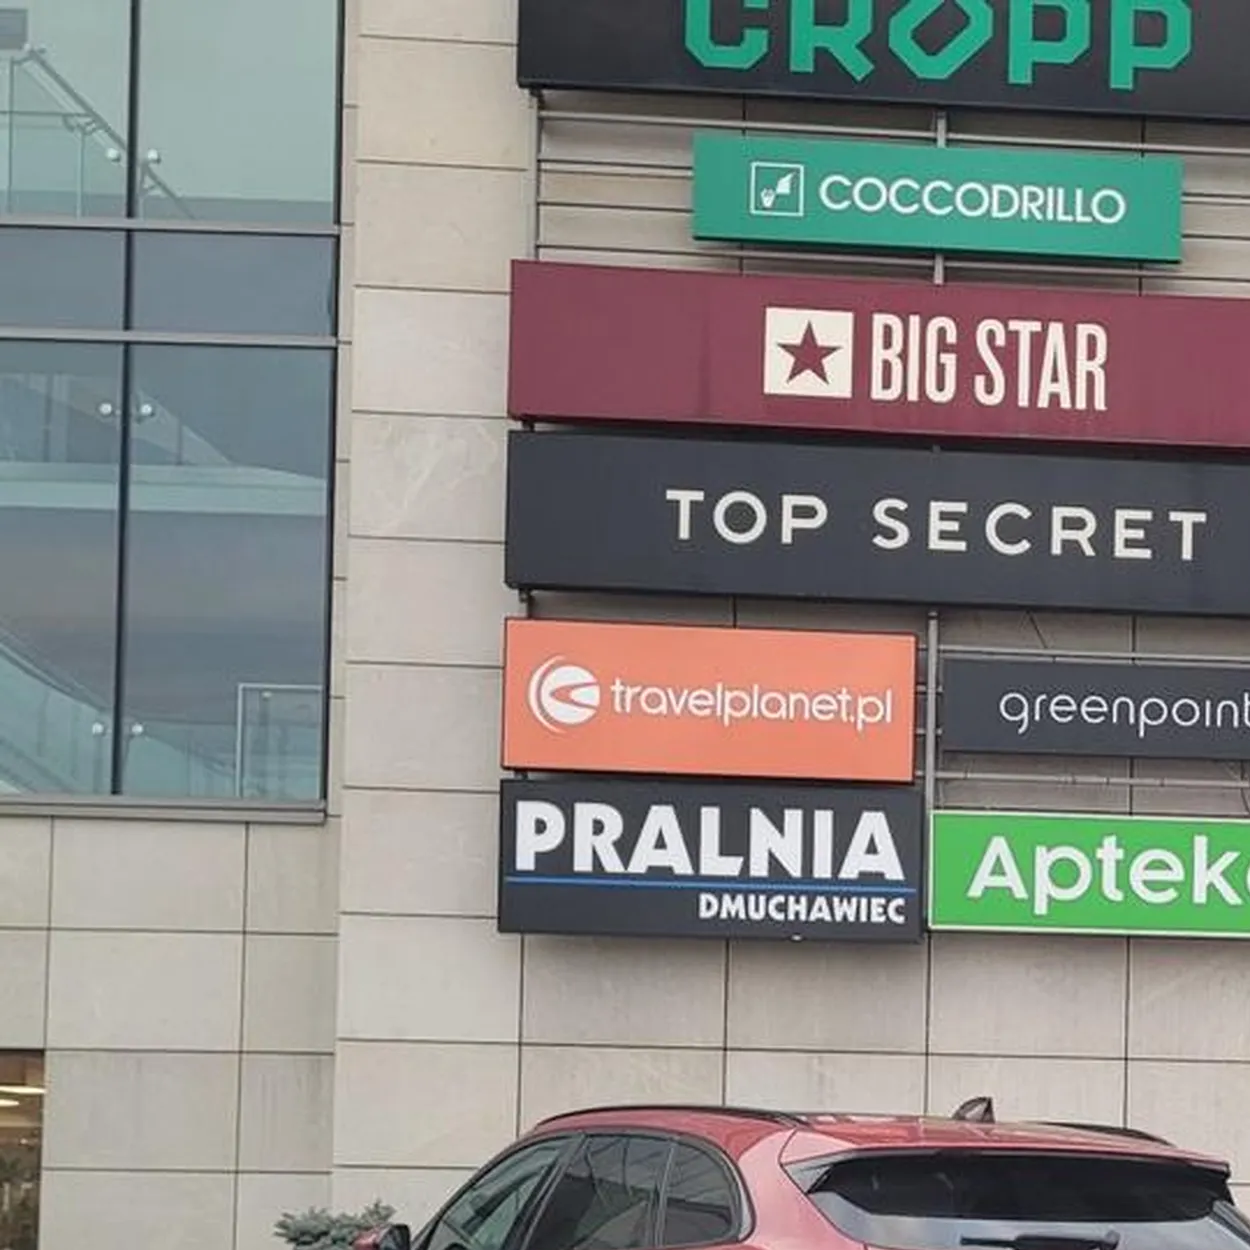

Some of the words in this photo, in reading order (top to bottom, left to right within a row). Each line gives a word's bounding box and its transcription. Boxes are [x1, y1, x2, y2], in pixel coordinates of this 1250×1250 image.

[684, 0, 1194, 90] CROPP
[820, 176, 1125, 223] COCCODRILLO
[871, 314, 956, 402] BIG
[975, 320, 1106, 410] STAR
[666, 490, 827, 543] TOP
[873, 499, 1206, 560] SECRET
[611, 678, 891, 731] travelplanet.pl
[516, 801, 904, 880] PRALNIA
[700, 894, 904, 923] DMUCHAWIEC
